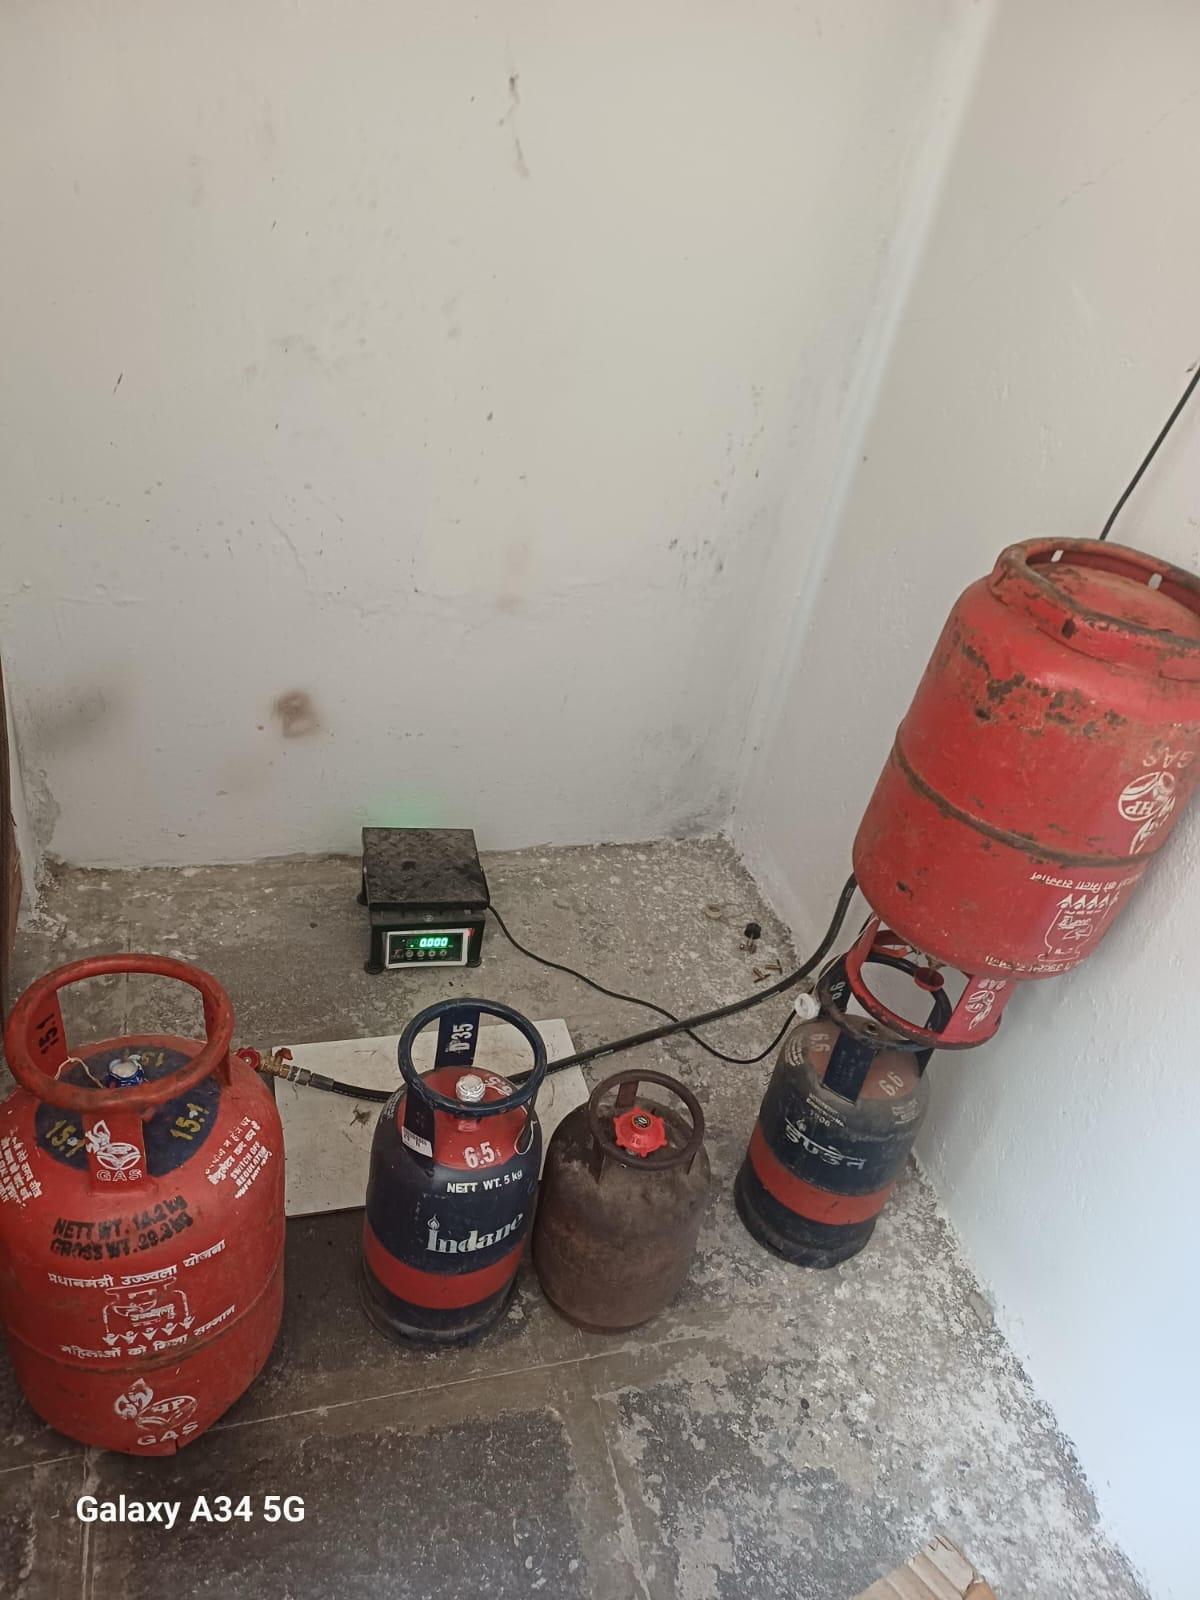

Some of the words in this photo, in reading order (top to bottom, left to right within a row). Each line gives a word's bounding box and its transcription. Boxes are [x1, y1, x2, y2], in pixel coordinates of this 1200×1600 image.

[1124, 800, 1153, 815] HP
[419, 937, 449, 948] 0.000
[96, 1169, 143, 1182] GAS
[230, 1151, 254, 1180] SWITCH
[446, 1182, 478, 1194] NETT
[482, 1177, 503, 1191] WT.
[503, 1174, 511, 1185] 5
[511, 1169, 524, 1182] kg
[53, 1217, 96, 1241] NETT
[50, 1237, 104, 1261] GROSS
[120, 1264, 178, 1287] उज्ज्वला
[182, 1239, 227, 1268] योजना
[127, 1344, 147, 1356] को
[137, 1421, 199, 1446] GAS
